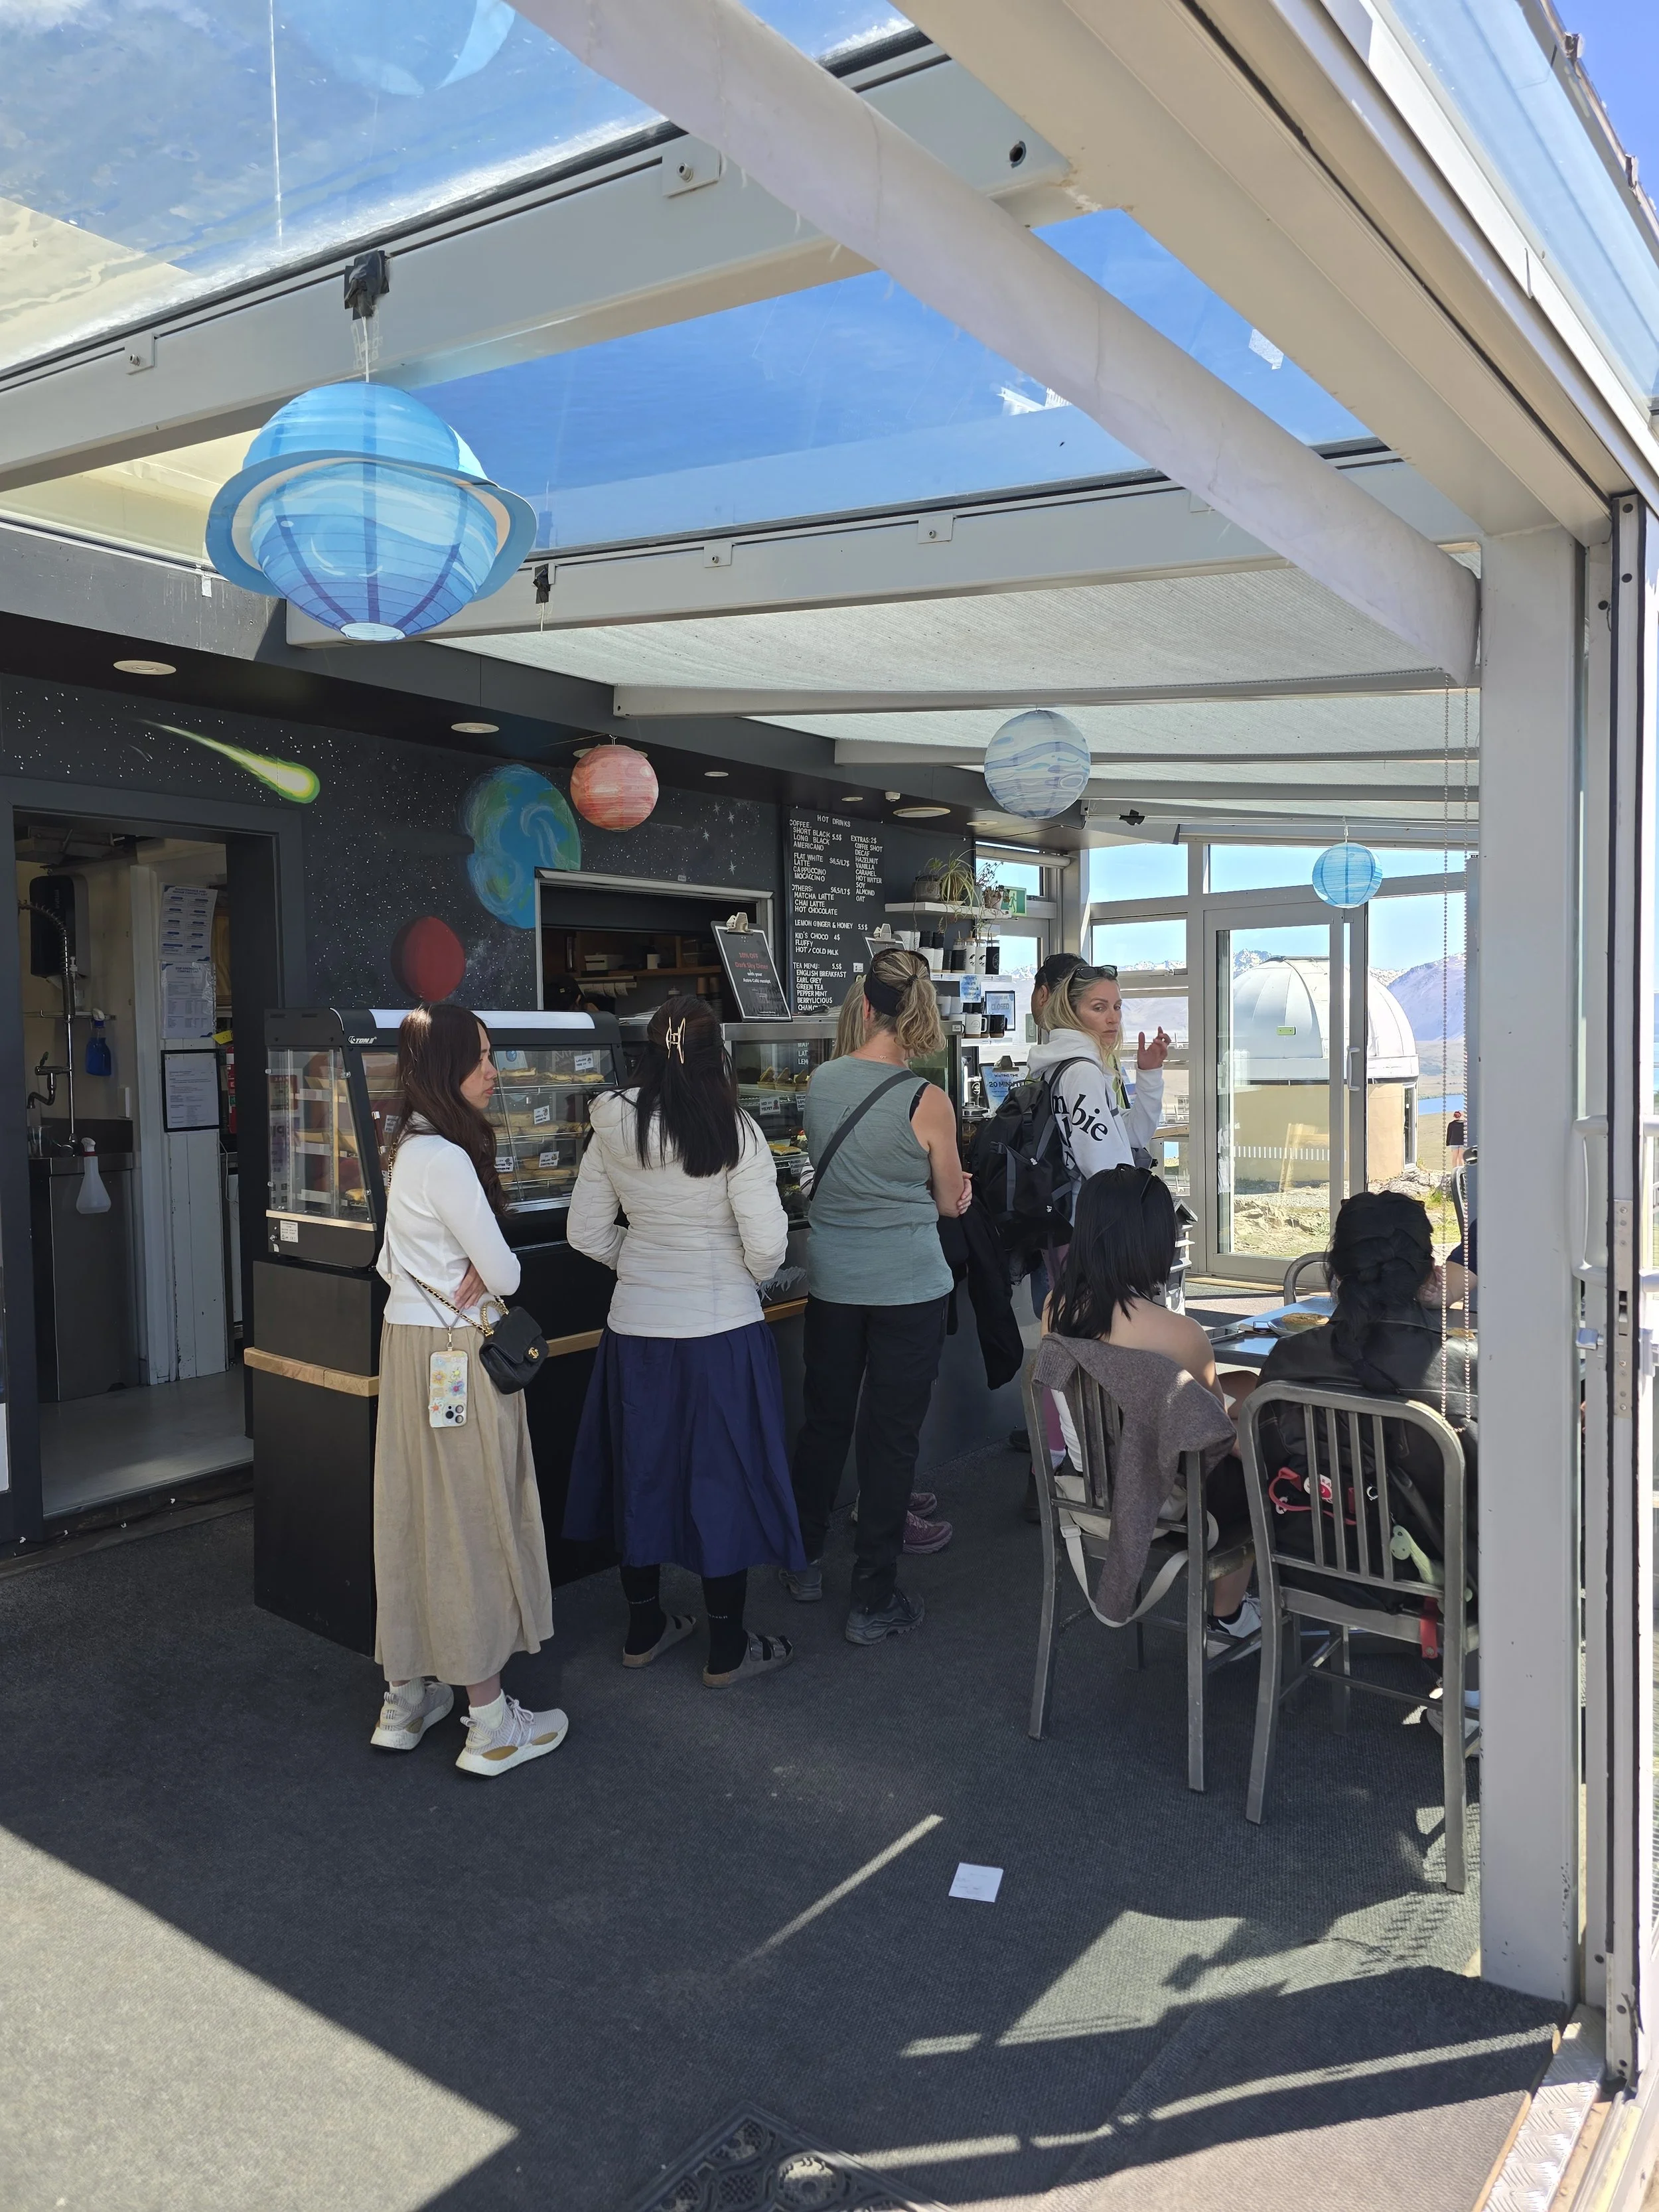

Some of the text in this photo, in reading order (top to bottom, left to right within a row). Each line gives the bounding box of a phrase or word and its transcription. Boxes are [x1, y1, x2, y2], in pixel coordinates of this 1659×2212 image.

[832, 819, 851, 828] DRINKS
[793, 842, 824, 851] AMERICANO
[793, 866, 826, 875] CAPPUCCINO
[794, 873, 825, 881] MOCACCINO
